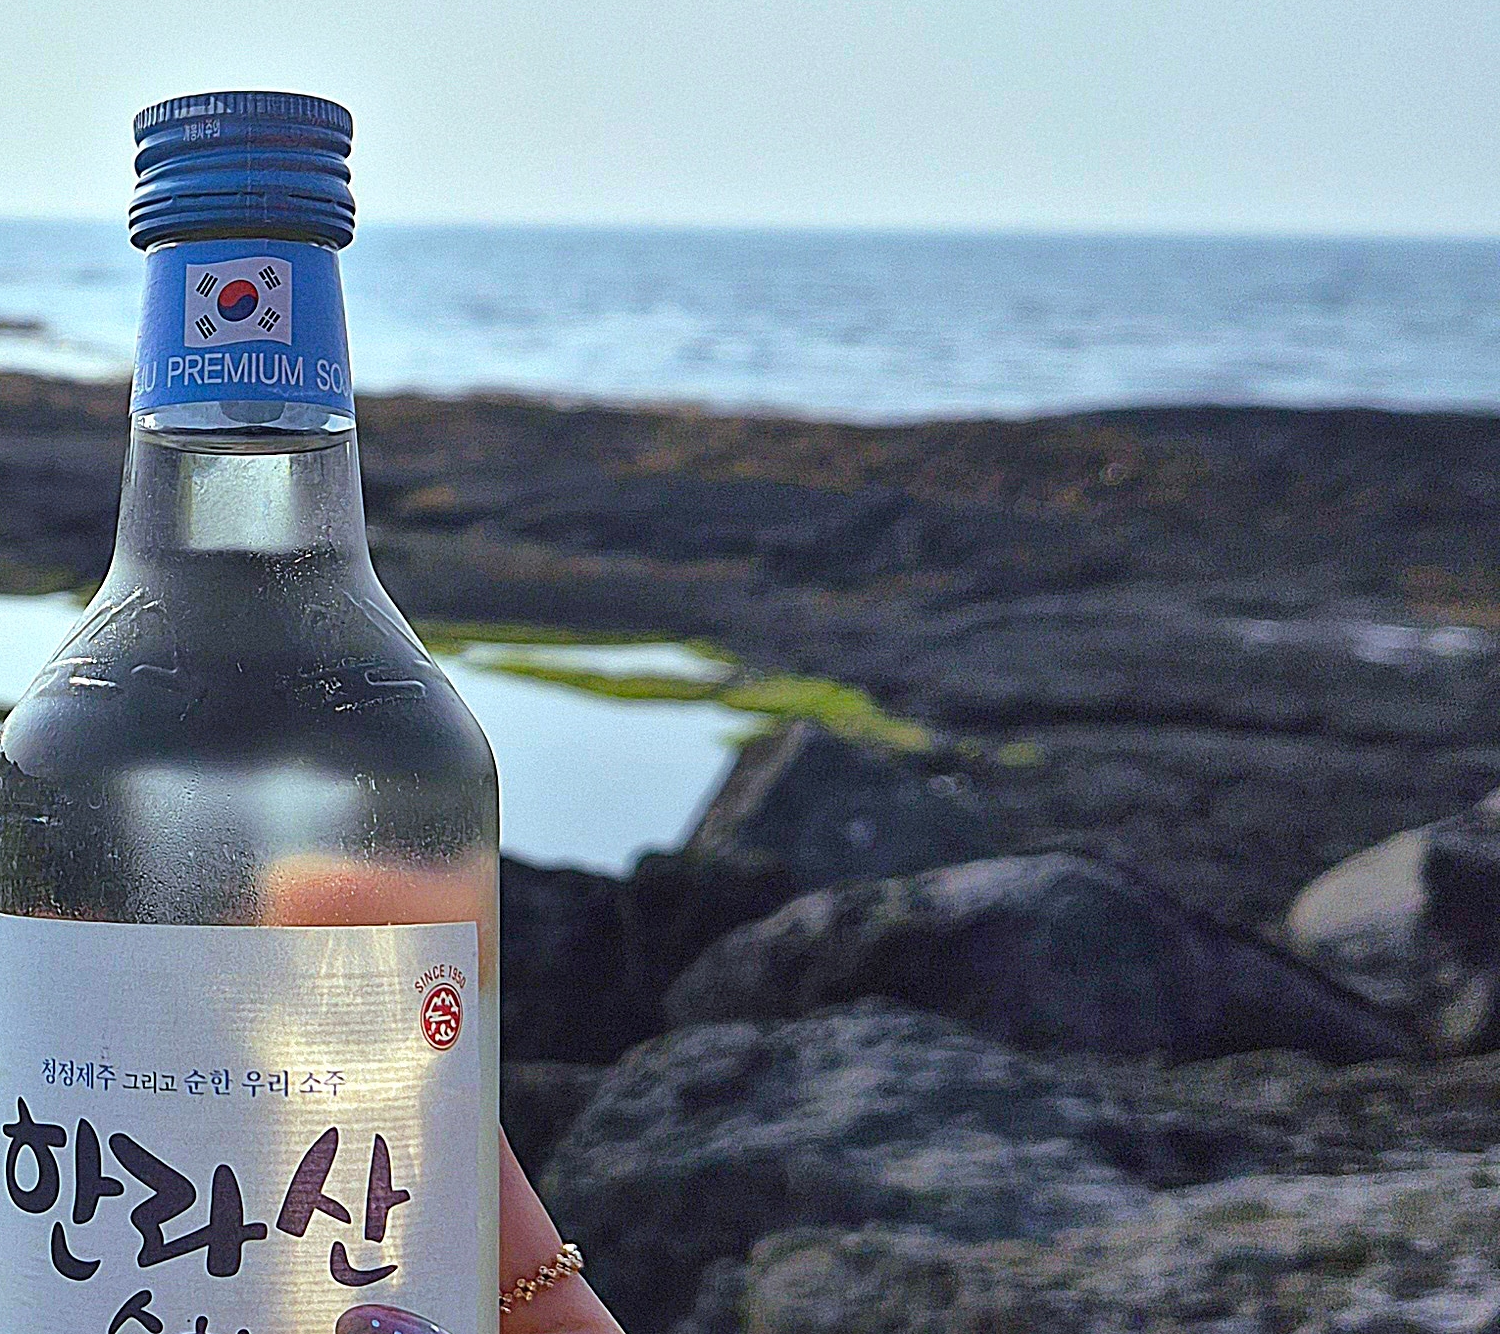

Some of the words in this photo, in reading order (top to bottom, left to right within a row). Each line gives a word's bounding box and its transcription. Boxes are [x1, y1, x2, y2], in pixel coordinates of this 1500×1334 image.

[167, 352, 304, 388] PREMIUM
[414, 963, 445, 994] SINCE
[448, 965, 467, 989] 1950
[41, 1057, 117, 1091] 청정제주
[122, 1069, 178, 1095] 그리고
[184, 1069, 232, 1096] 순한
[241, 1069, 290, 1098] 우리
[299, 1069, 347, 1097] 소주
[2, 1096, 411, 1287] 한라산
